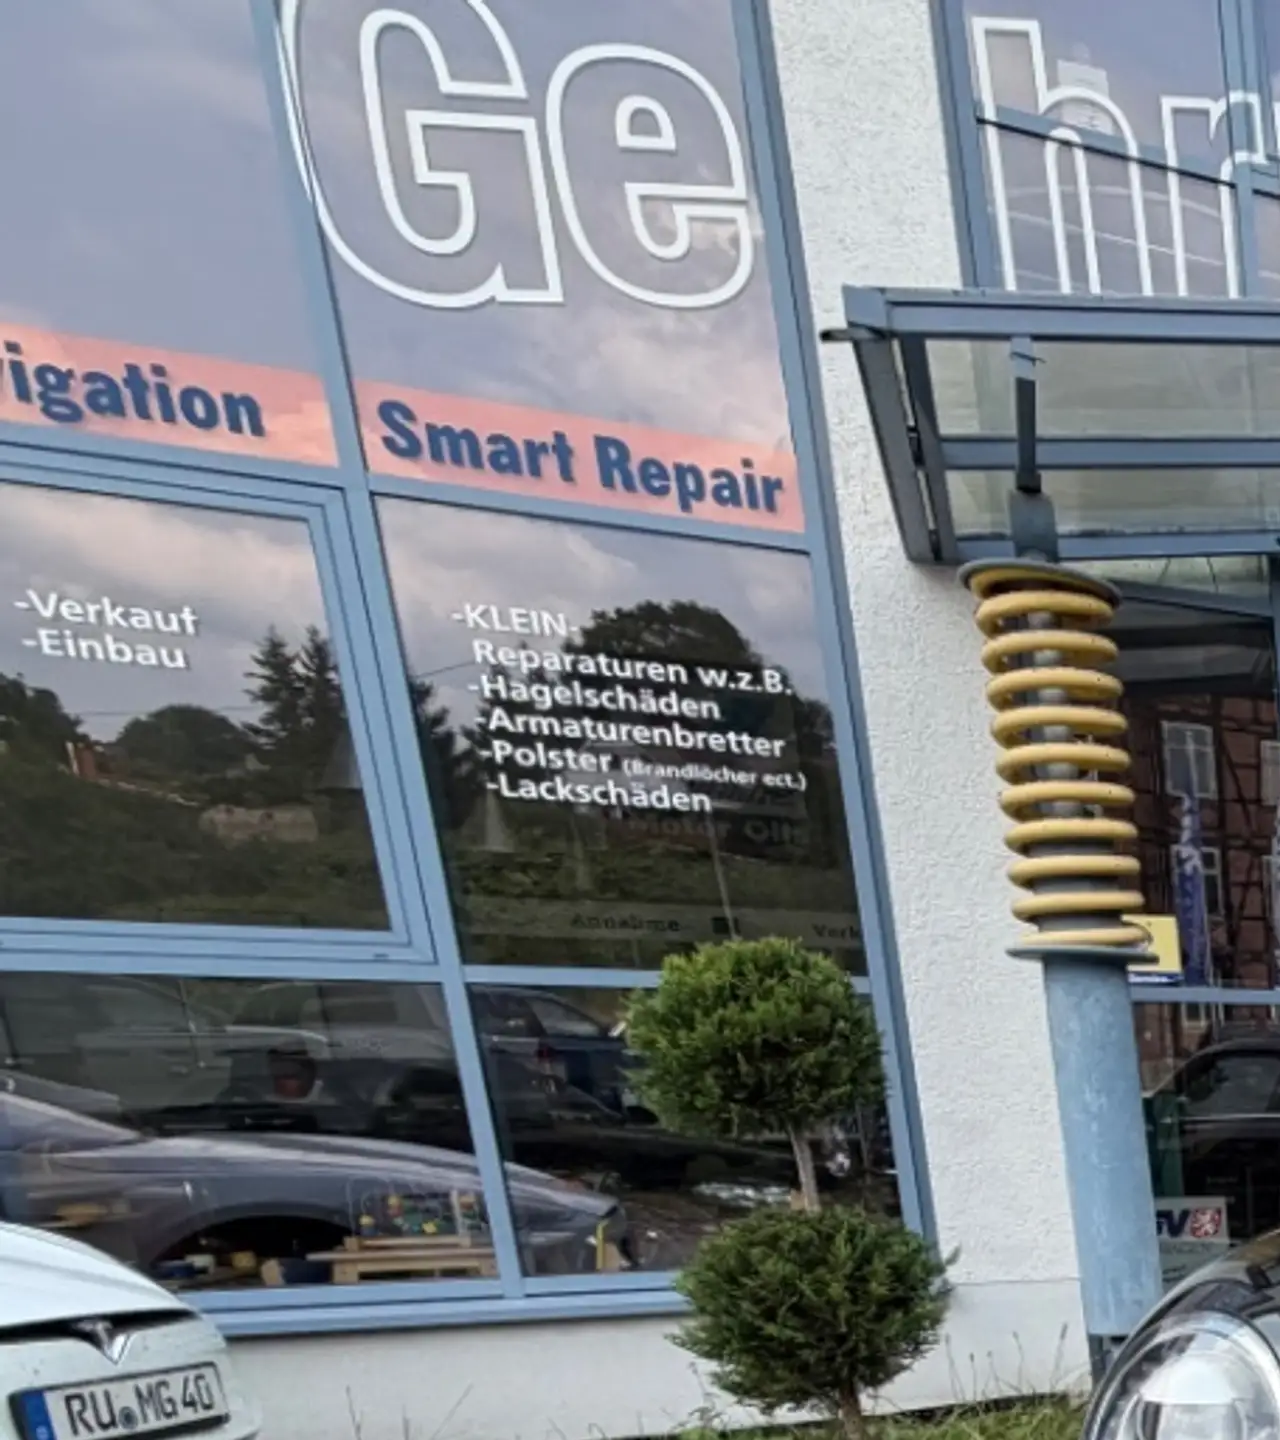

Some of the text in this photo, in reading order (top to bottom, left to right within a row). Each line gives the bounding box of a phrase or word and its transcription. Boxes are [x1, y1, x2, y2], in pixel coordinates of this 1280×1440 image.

[0, 341, 266, 437] igation
[377, 400, 784, 513] Smart Repair
[22, 628, 188, 669] -Einbau
[472, 639, 689, 685] Reparaturen
[468, 675, 722, 722] -Hagelschäden
[474, 706, 788, 759] -Armaturenbretter
[480, 739, 613, 774] -Polster
[487, 773, 714, 812] -Lackschäden
[64, 1374, 214, 1436] RU MG 40
